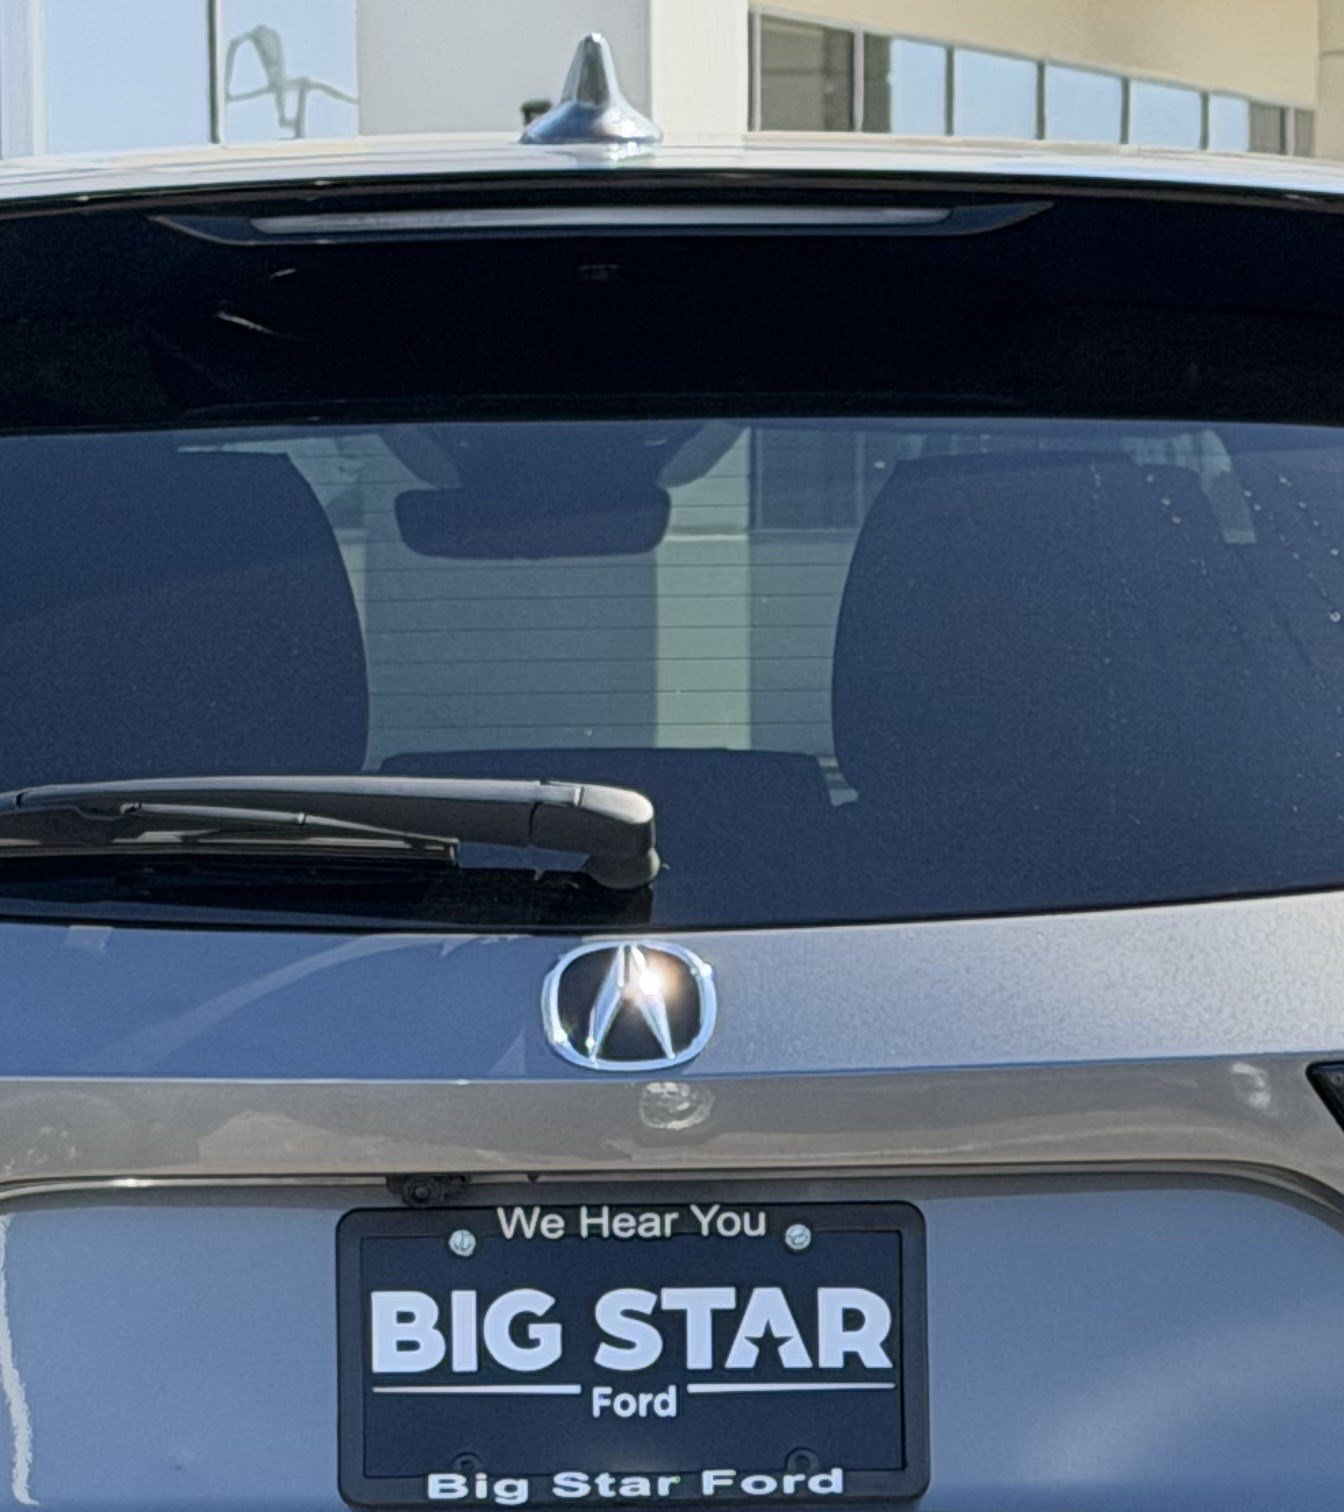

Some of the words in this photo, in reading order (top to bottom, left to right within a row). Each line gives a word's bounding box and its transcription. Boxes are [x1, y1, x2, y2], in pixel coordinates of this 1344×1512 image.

[497, 1207, 565, 1239] We
[580, 1206, 679, 1238] Hear
[690, 1204, 767, 1237] You
[370, 1288, 562, 1373] BIG
[594, 1287, 894, 1372] STAR
[592, 1386, 677, 1417] Ford
[428, 1473, 529, 1504] Big
[552, 1471, 681, 1499] Star
[702, 1468, 844, 1496] Ford
